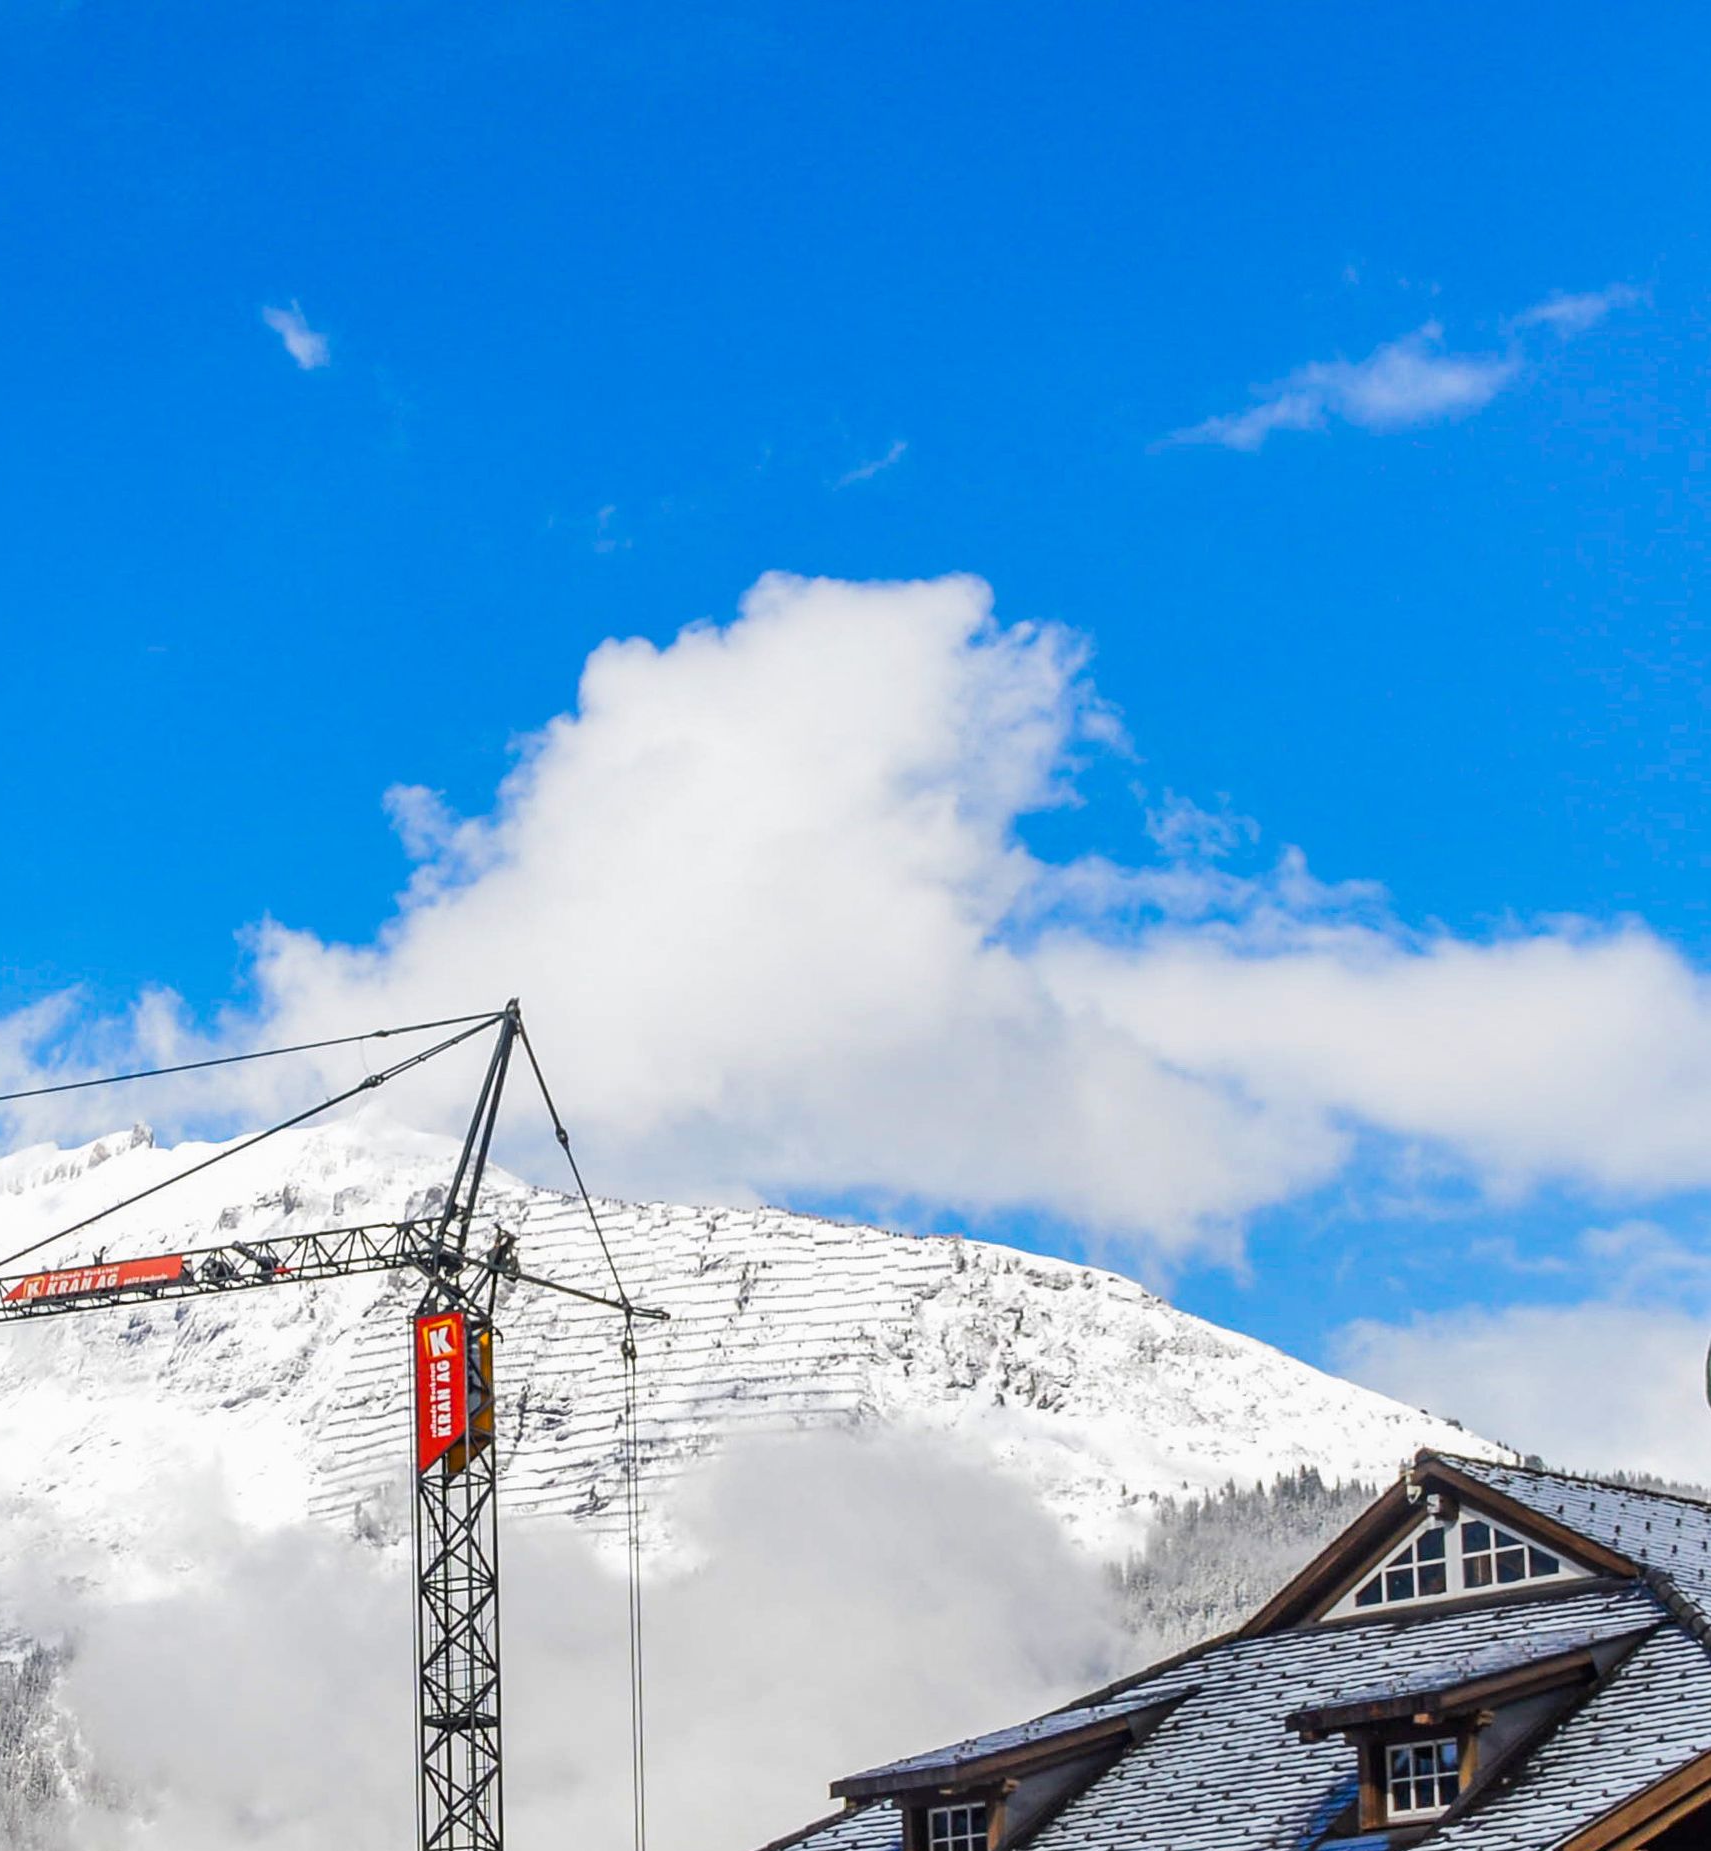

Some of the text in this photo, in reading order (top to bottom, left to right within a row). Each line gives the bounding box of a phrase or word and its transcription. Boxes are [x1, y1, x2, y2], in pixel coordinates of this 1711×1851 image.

[28, 1281, 41, 1297] K
[46, 1273, 118, 1296] KRAN AG
[429, 1326, 454, 1358] K
[436, 1359, 452, 1438] KRAN AG
